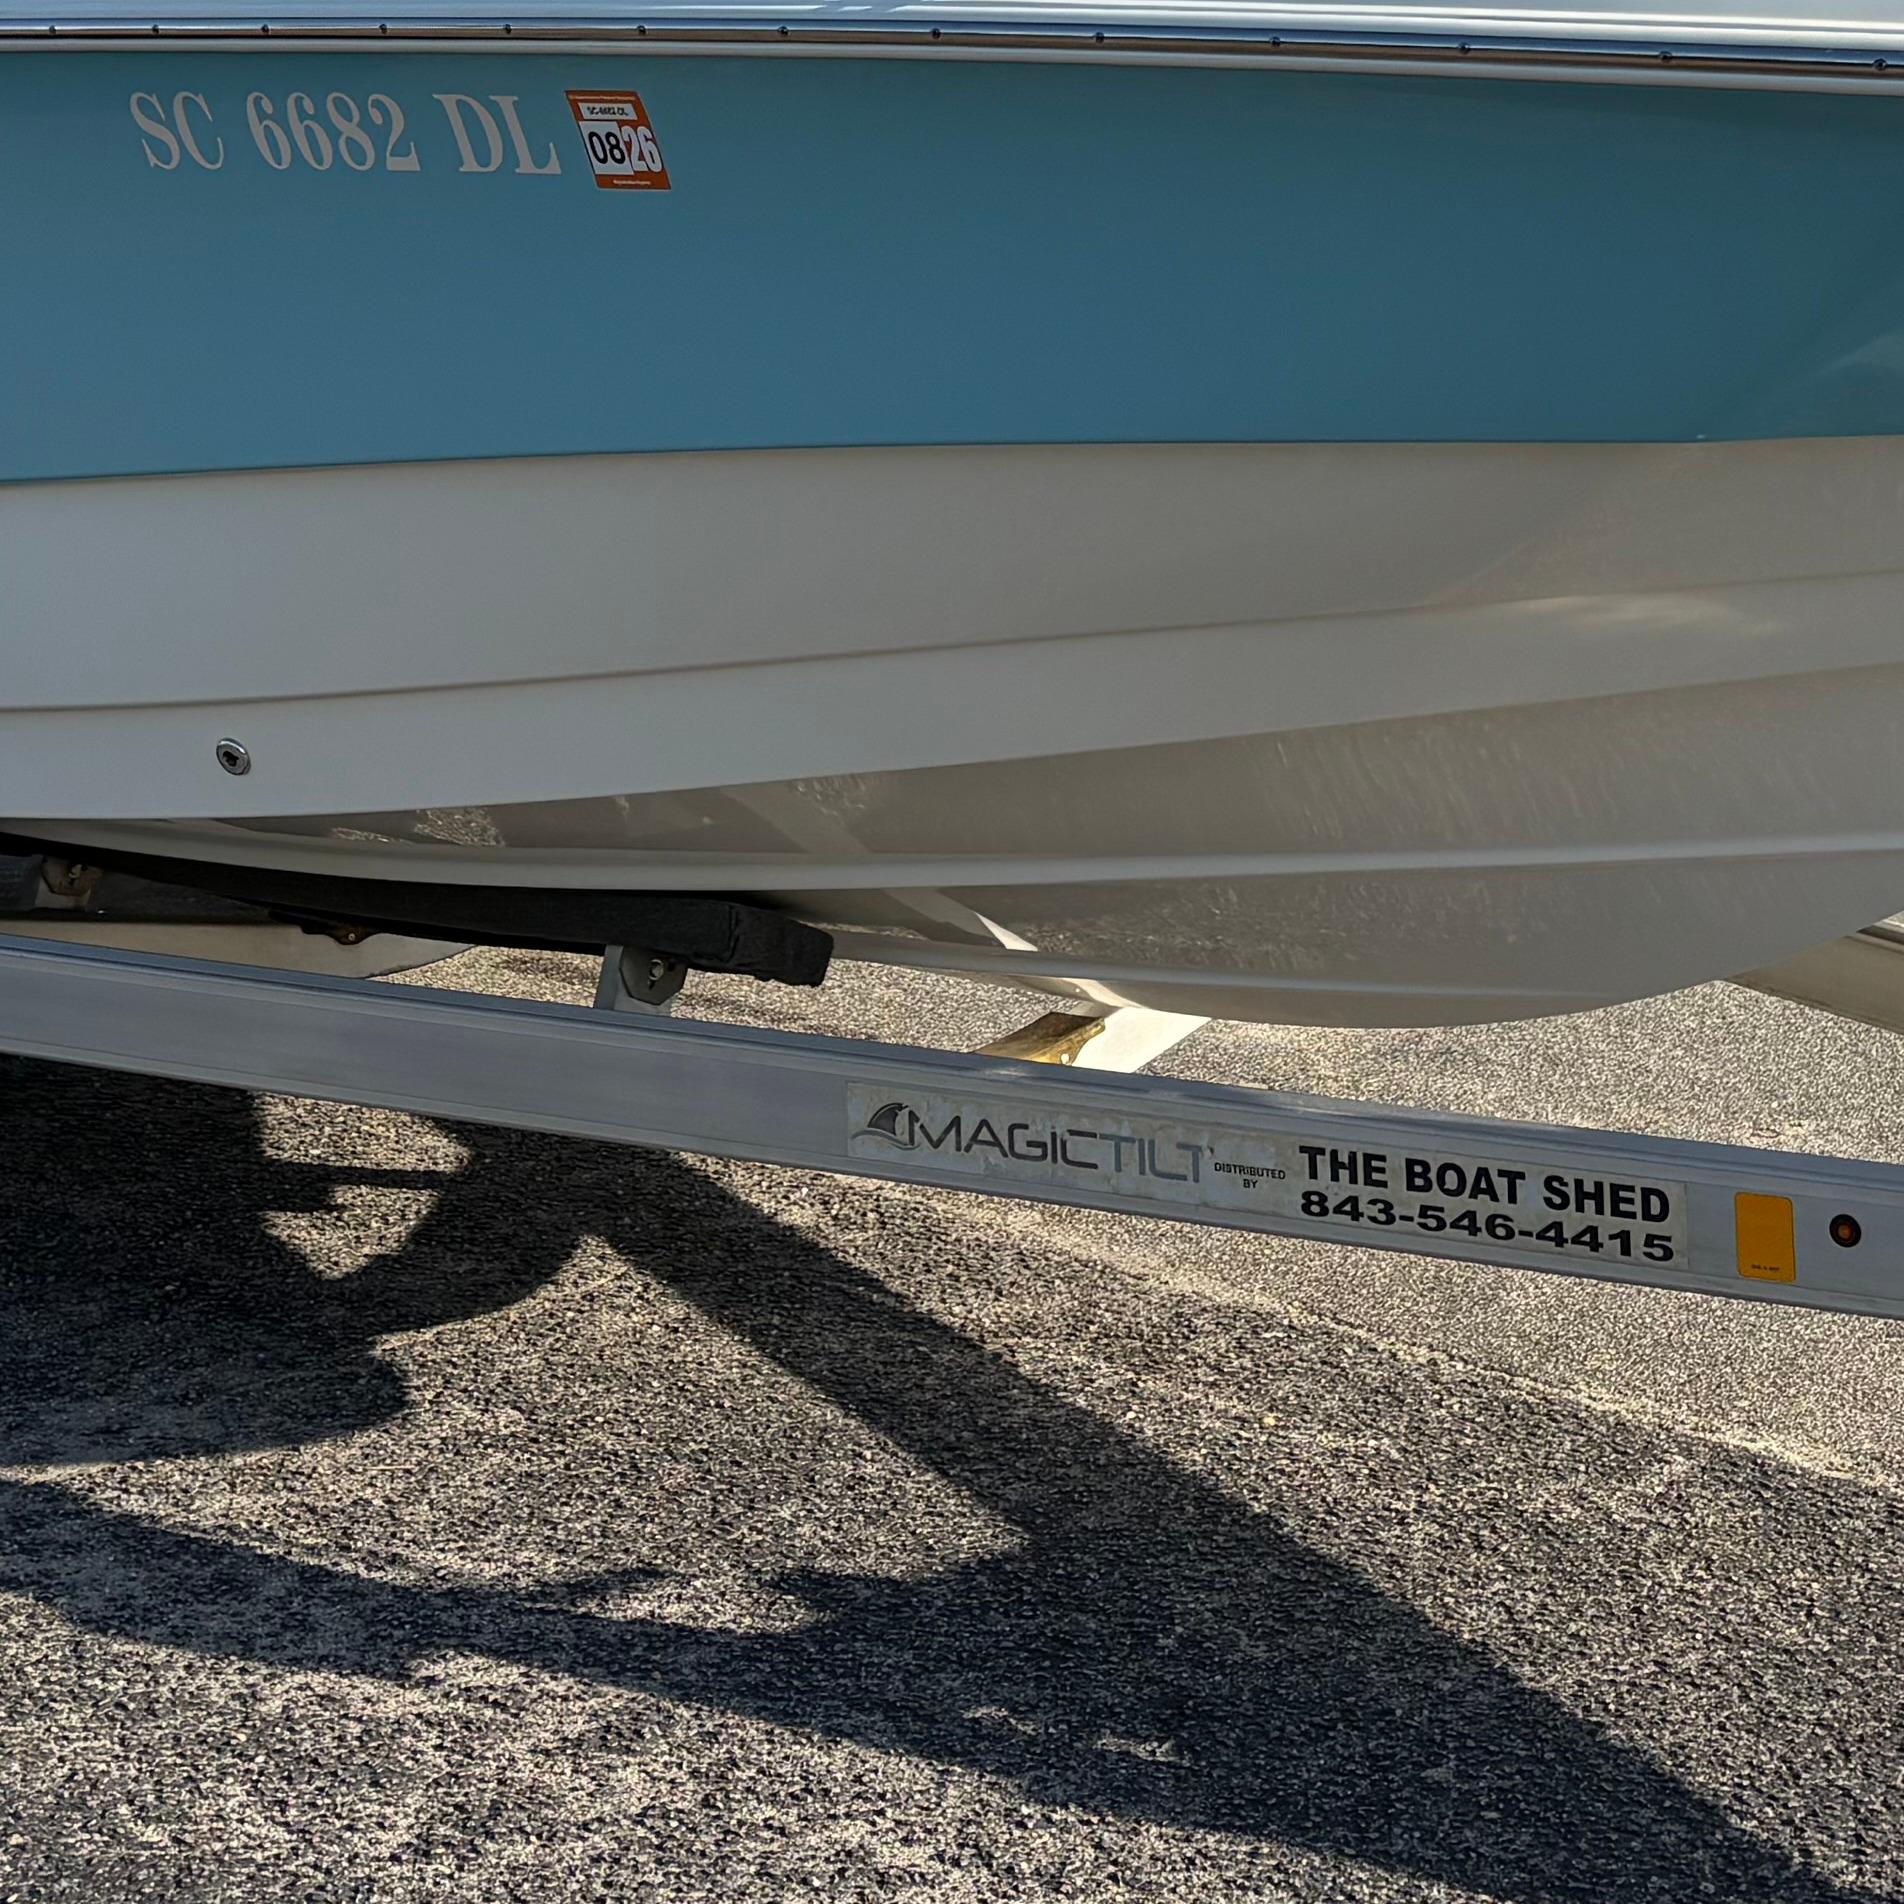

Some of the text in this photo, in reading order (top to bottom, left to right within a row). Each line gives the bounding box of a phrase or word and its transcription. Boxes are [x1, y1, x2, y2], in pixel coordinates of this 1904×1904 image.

[129, 91, 562, 175] SC 6682 DL
[588, 126, 663, 172] 08 26
[1214, 1161, 1286, 1180] DISTRIBUTED
[1242, 1178, 1259, 1190] BY
[1299, 1144, 1670, 1223] THE BOAT SHED
[1300, 1190, 1676, 1263] 843-546-4415
